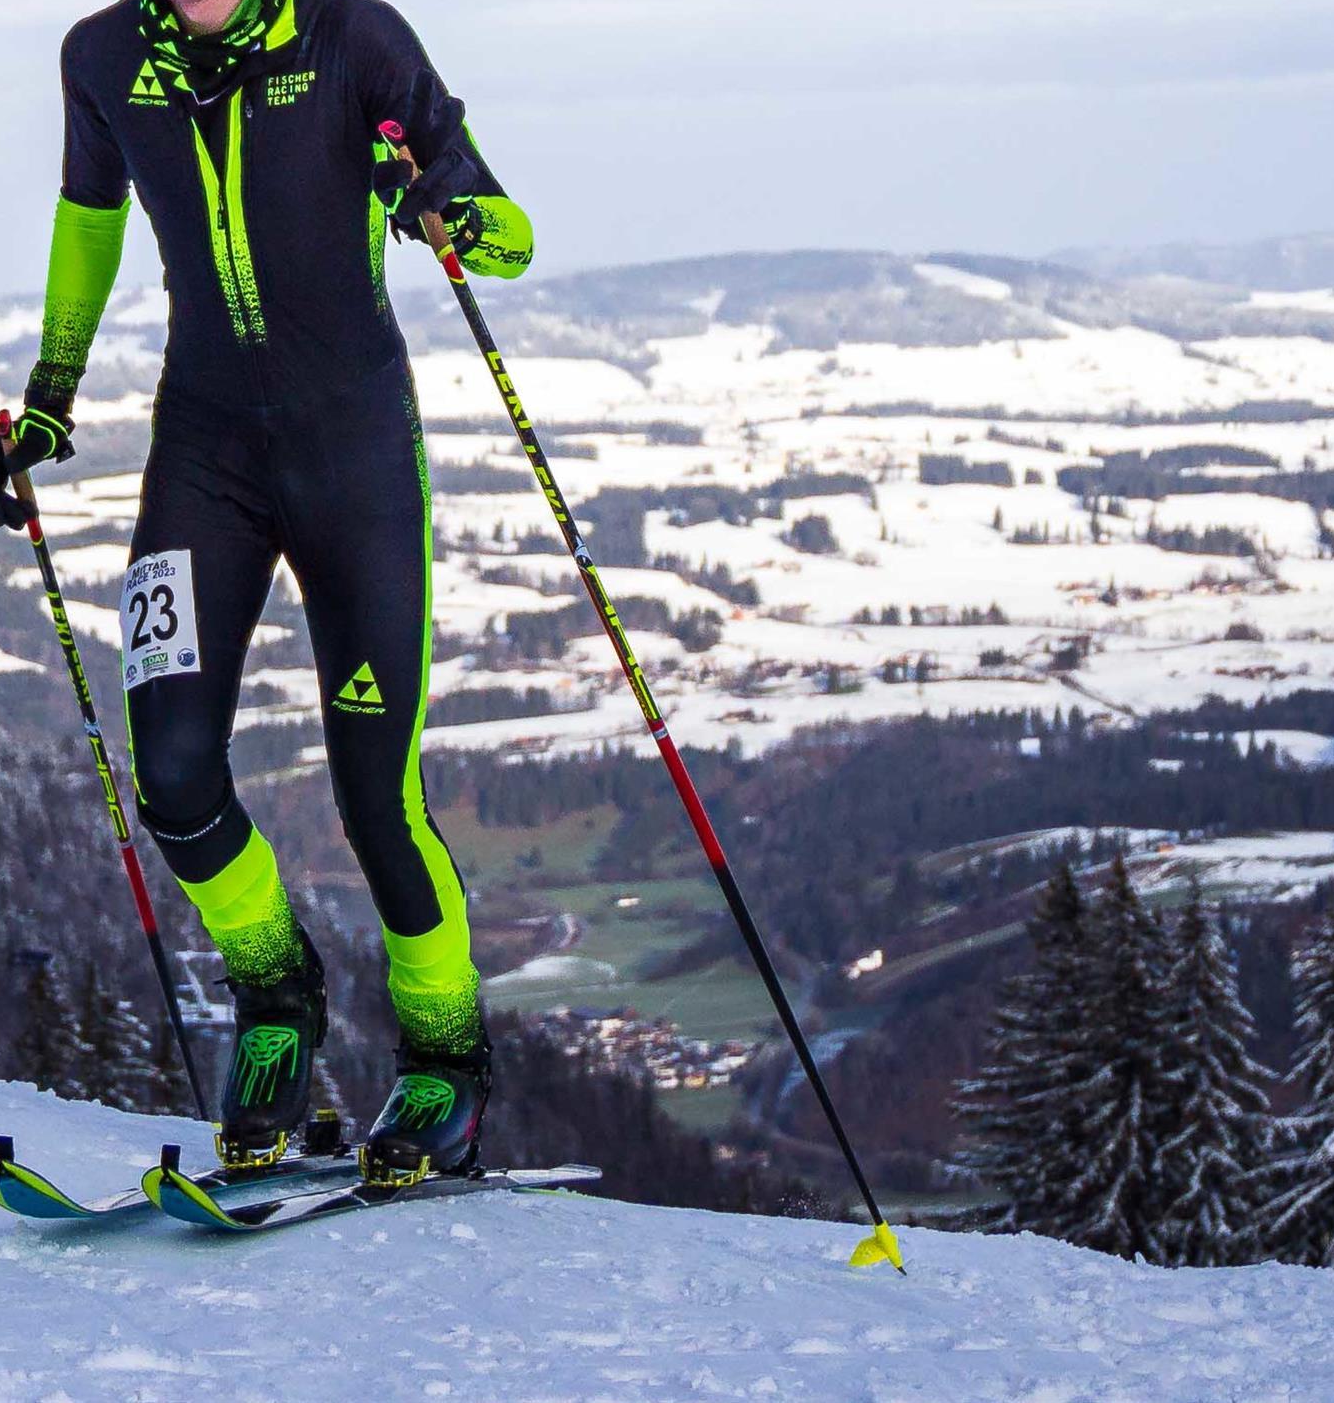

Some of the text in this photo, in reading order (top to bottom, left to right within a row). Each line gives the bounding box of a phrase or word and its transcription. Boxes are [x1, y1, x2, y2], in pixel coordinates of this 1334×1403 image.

[267, 70, 316, 87] FISCHER
[267, 82, 309, 97] RACING
[127, 97, 169, 107] FISCHER
[267, 95, 295, 107] TEAM
[475, 241, 527, 264] FSCHER
[487, 350, 532, 429] LEKI
[130, 559, 169, 581] MITTAG
[125, 566, 176, 593] RACE 2023
[128, 583, 179, 653] 23
[148, 653, 168, 665] DAV
[331, 700, 386, 714] FISCHER
